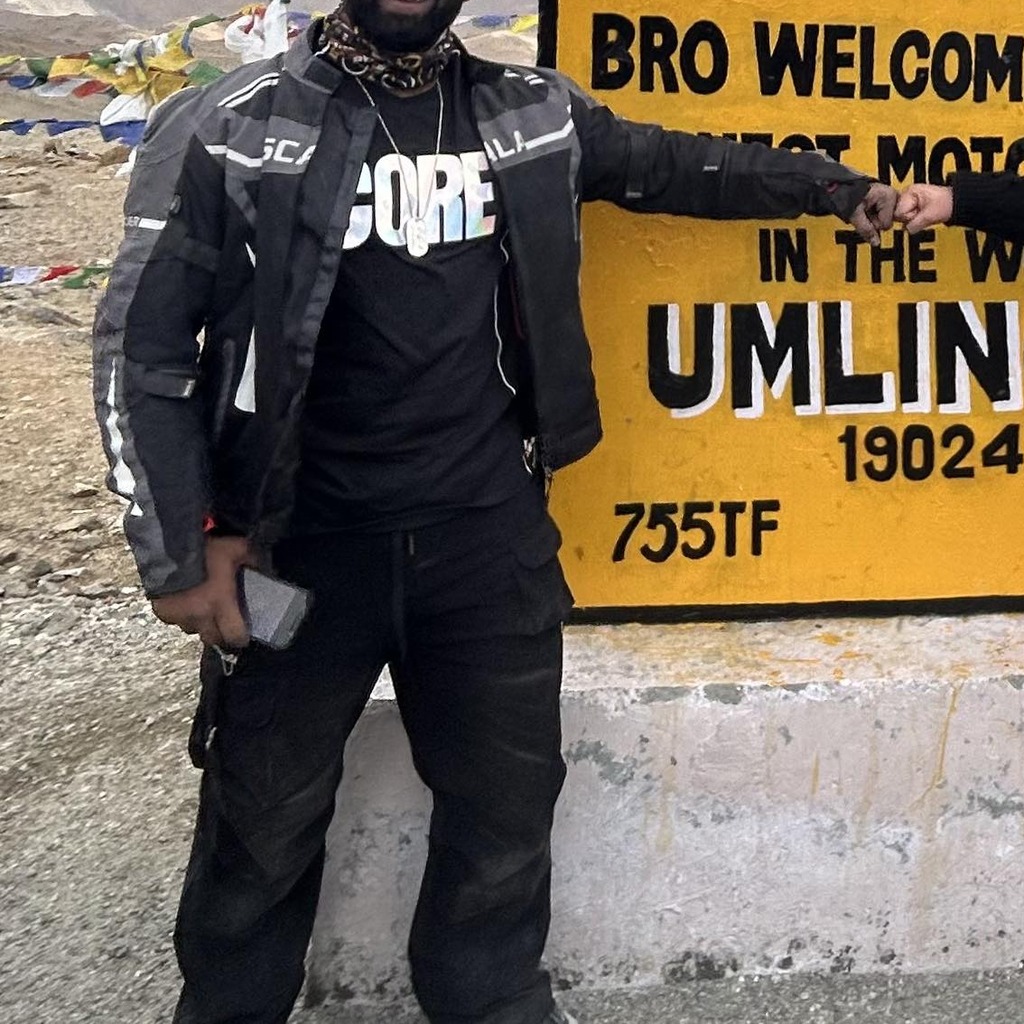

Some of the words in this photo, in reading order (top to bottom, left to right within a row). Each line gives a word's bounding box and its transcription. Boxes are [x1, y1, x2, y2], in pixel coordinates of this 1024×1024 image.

[591, 13, 729, 95] BRO
[758, 228, 809, 283] IN
[835, 229, 937, 284] THE
[838, 423, 1024, 482] 19024
[612, 499, 781, 563] 755TF
